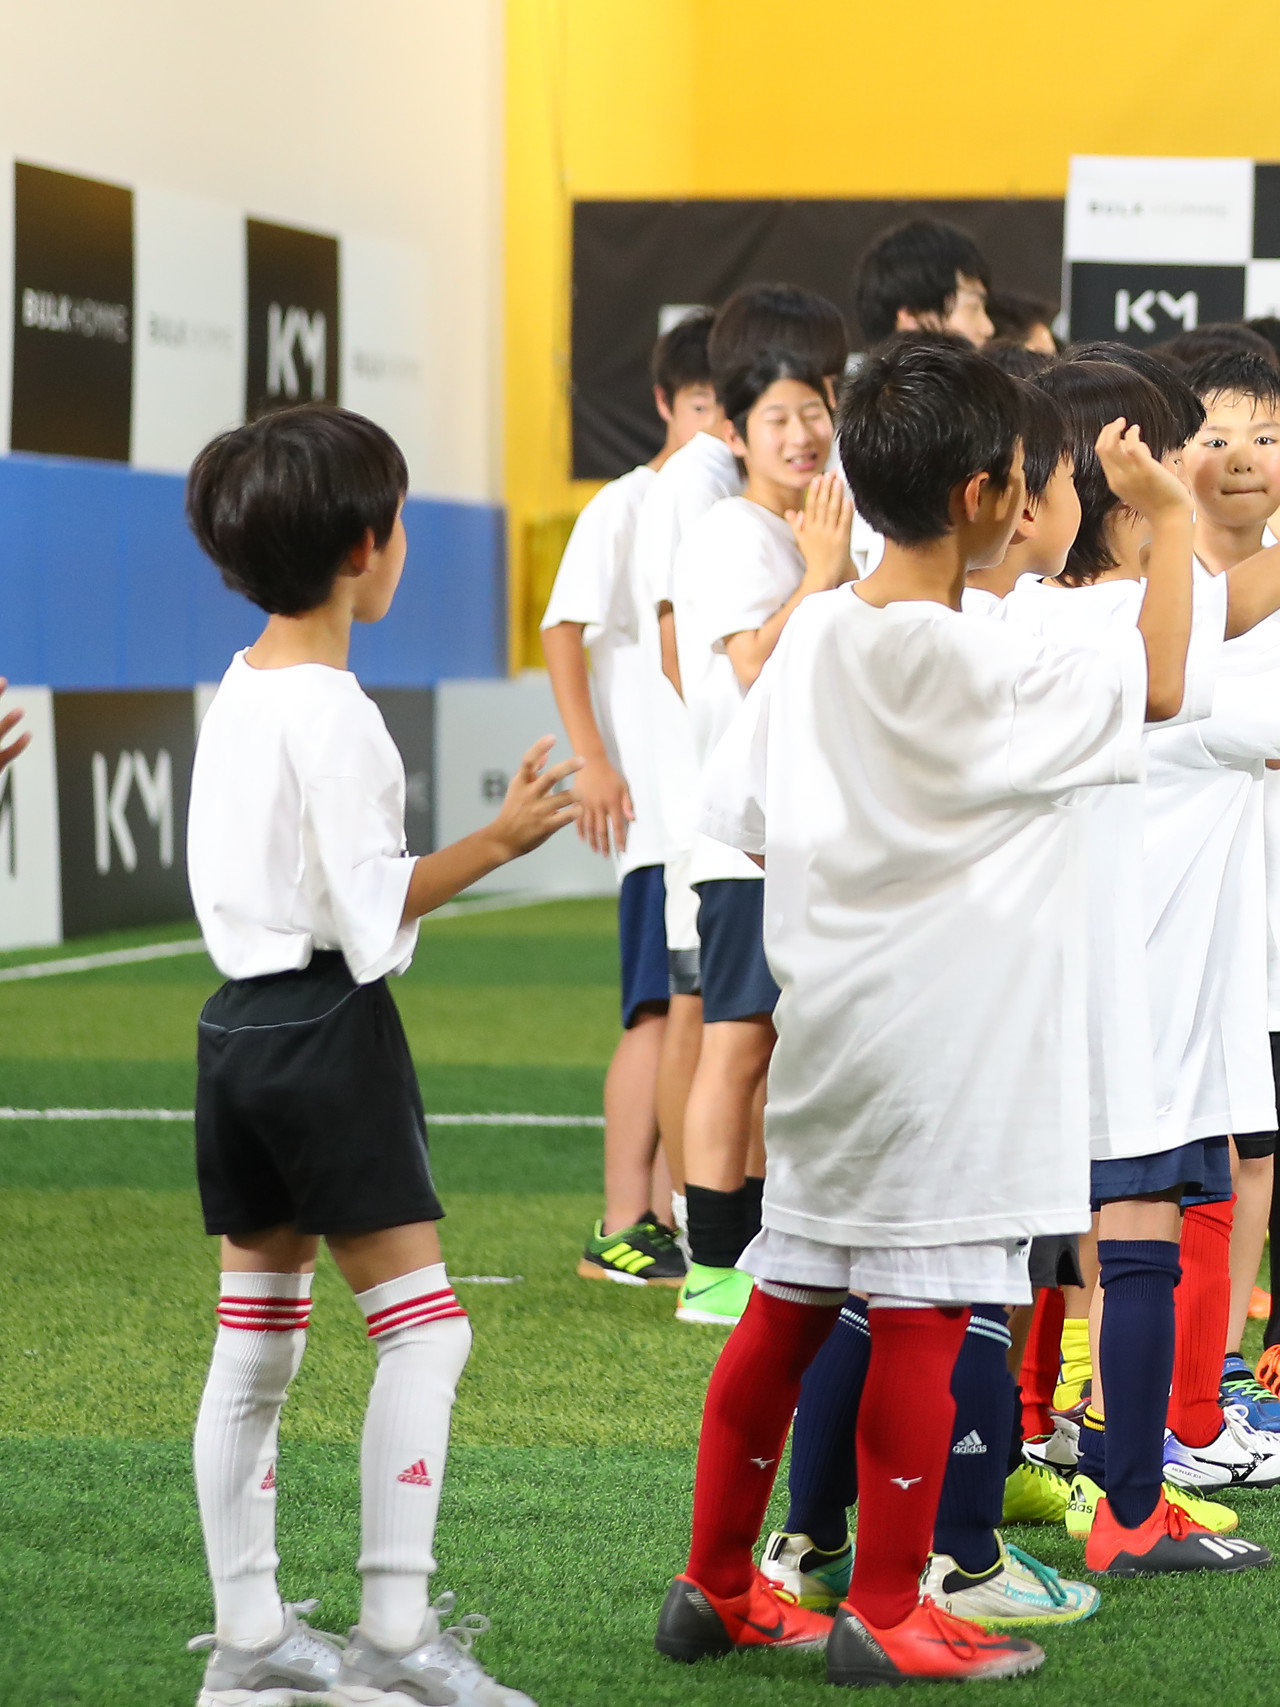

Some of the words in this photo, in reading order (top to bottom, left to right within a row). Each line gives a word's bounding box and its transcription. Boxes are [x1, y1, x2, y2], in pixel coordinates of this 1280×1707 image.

[1114, 289, 1198, 332] KM
[92, 750, 174, 876] KM
[952, 1444, 988, 1455] adidas
